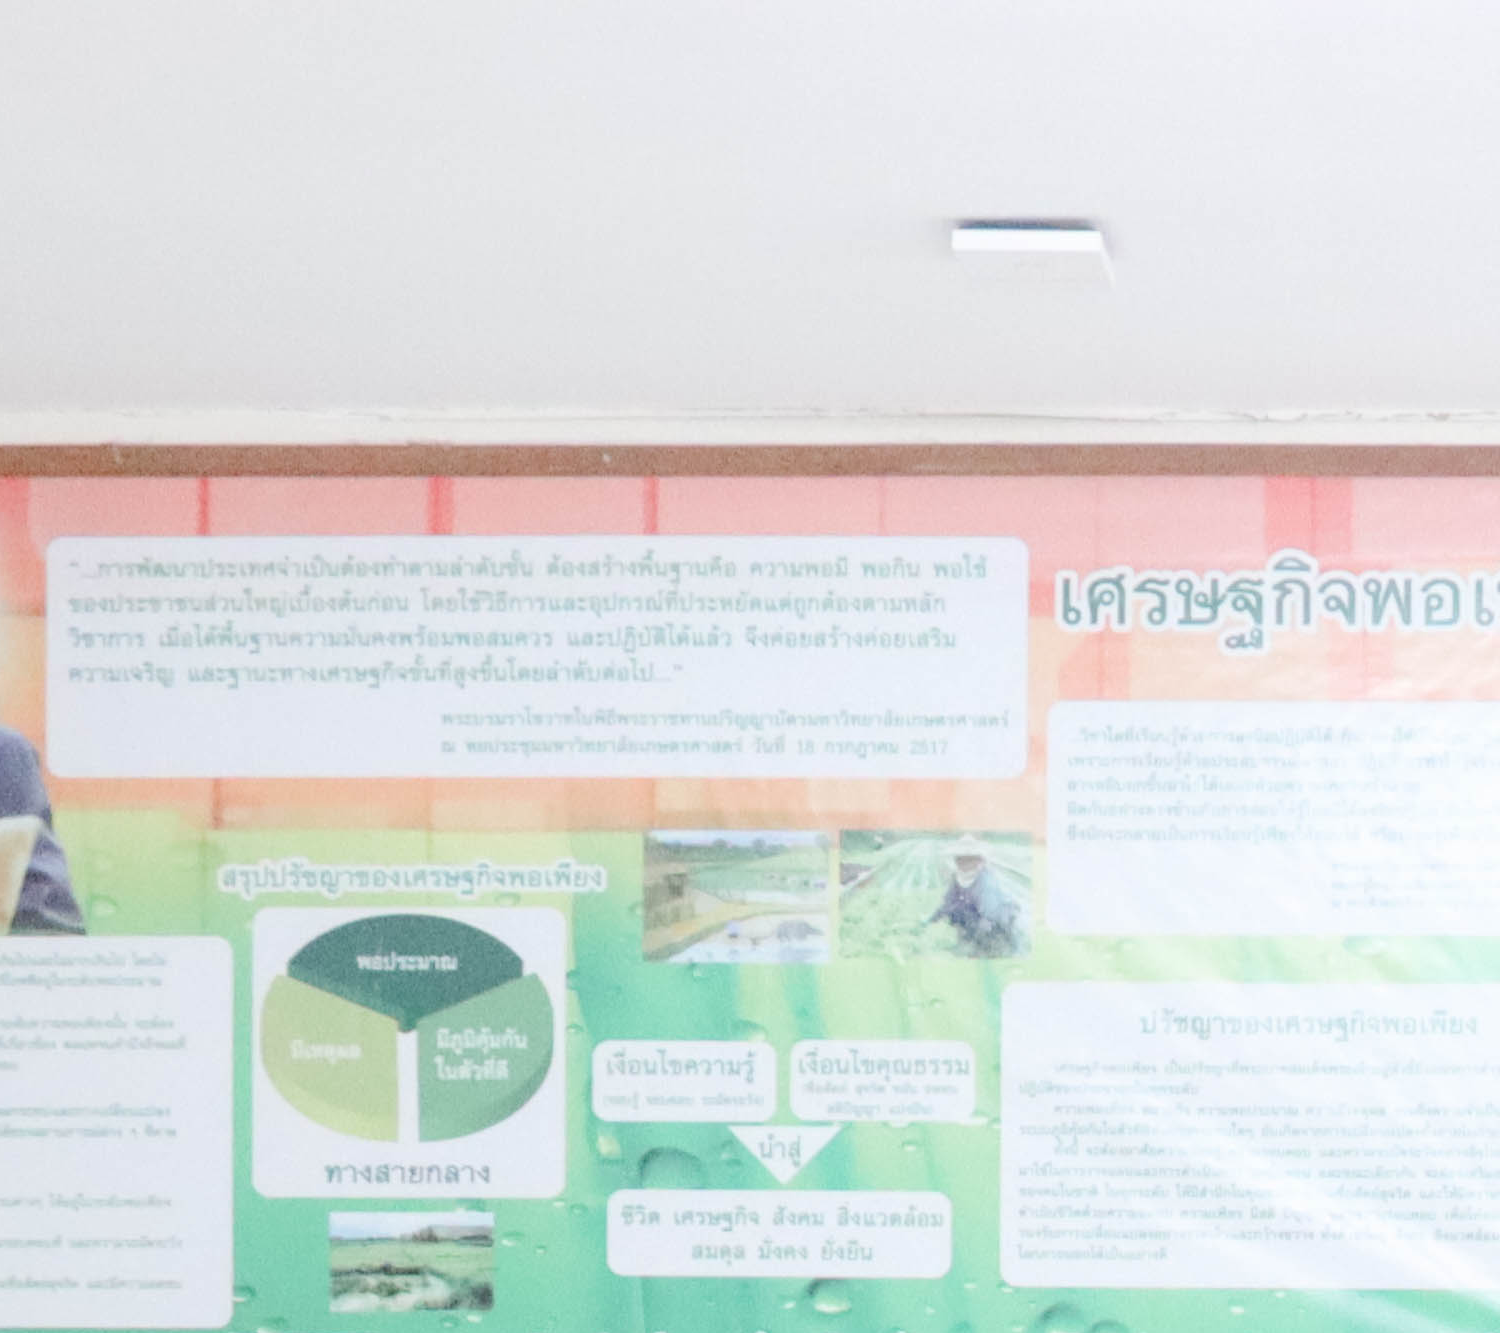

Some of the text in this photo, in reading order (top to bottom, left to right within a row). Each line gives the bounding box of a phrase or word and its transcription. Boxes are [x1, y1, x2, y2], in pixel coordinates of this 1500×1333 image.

[220, 861, 603, 896] สรุปปรัชญาของเศรษฐกิจพอเพียง
[357, 953, 458, 971] พอประมาณ
[436, 1028, 528, 1058] มีภูมิคุ้มกัน
[434, 1056, 510, 1081] ในตัวที่ดี
[605, 1049, 756, 1083] เงื่อนไขความรู้
[799, 1047, 971, 1083] เงื่อนไขคุณธรรม
[758, 1134, 802, 1168] นำสู่
[324, 1162, 491, 1186] ทางสายกลาง
[620, 1203, 944, 1232] ชีวิต เศรษฐกิจ สังคม สิ่งแวดล้อม
[692, 1239, 873, 1266] สมดุล มั่นคง ยั่งยืน
